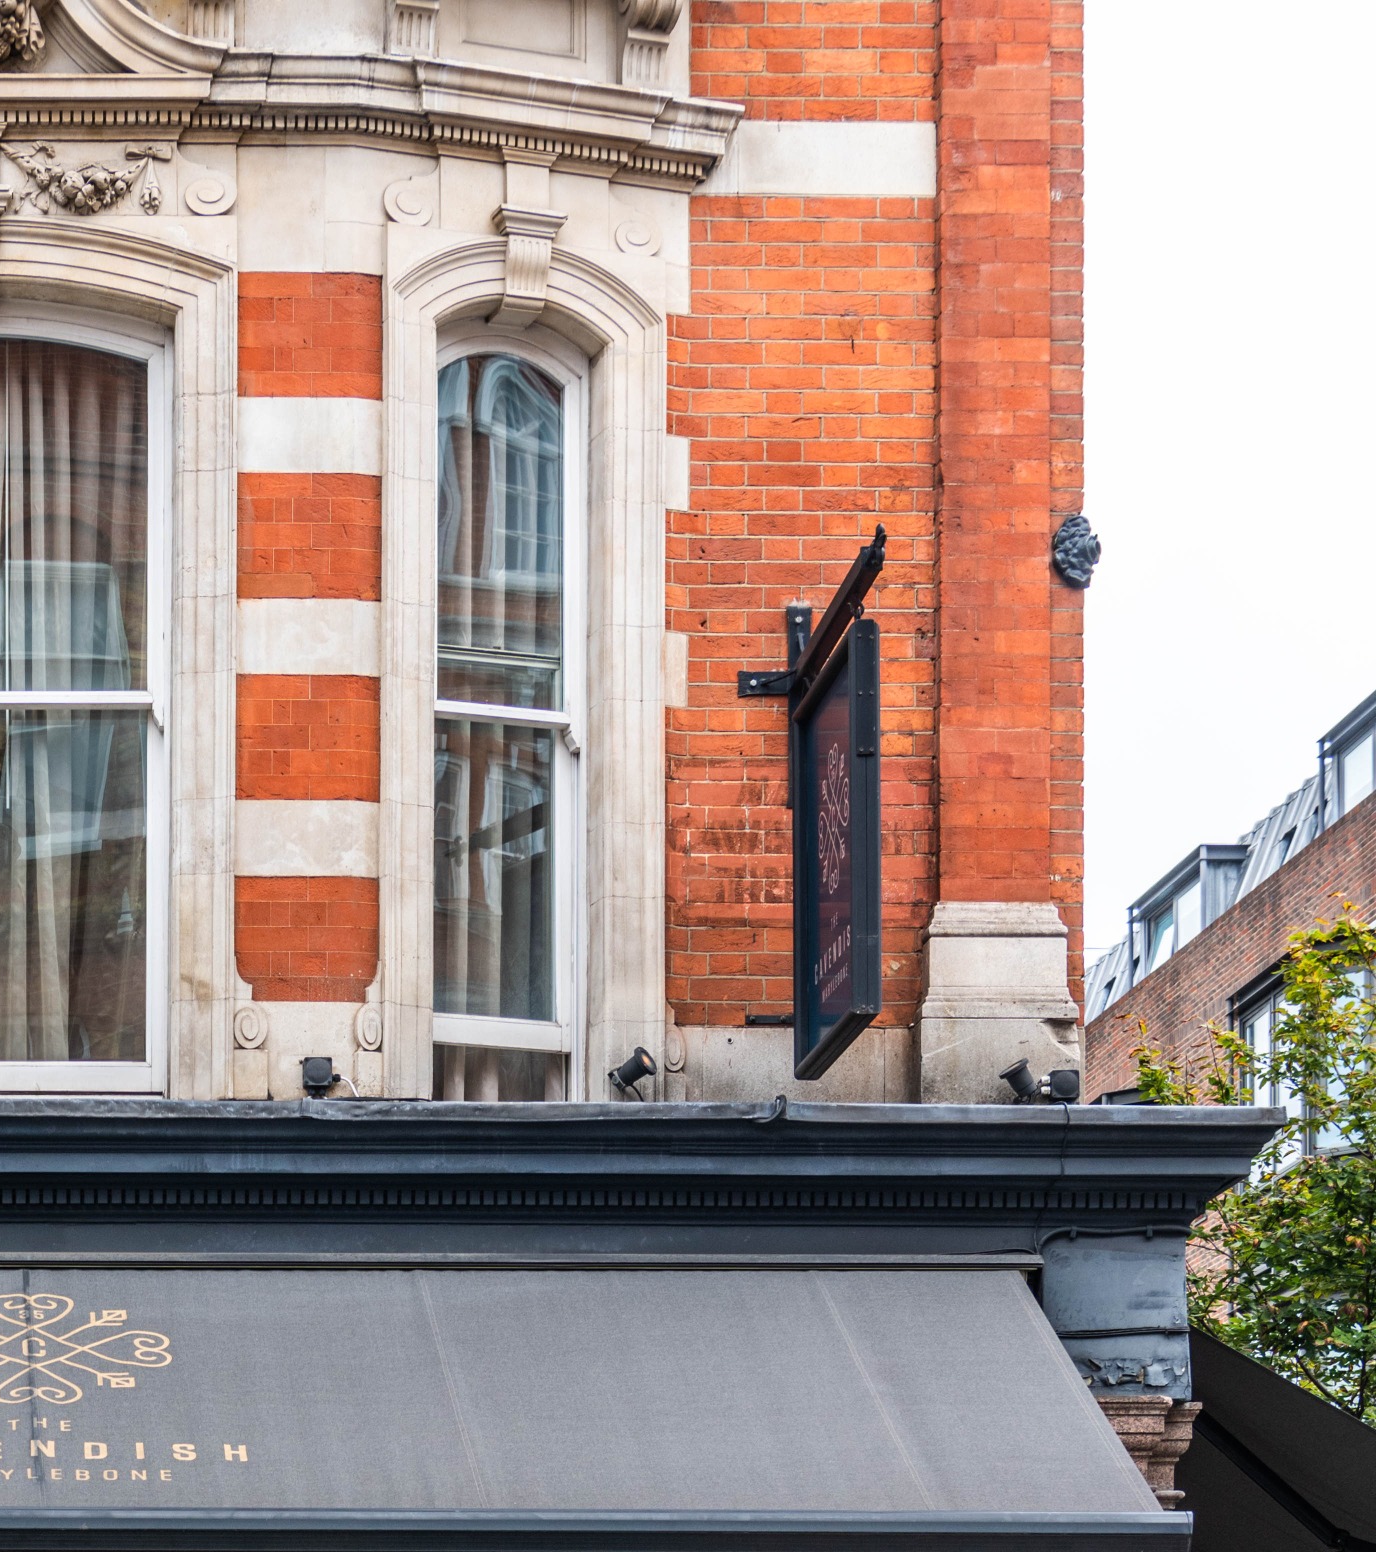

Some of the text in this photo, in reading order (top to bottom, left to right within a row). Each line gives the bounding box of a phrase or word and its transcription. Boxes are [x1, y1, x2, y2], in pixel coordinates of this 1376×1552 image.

[830, 912, 839, 931] THE
[821, 962, 849, 1004] MARYLEBONE
[18, 1310, 45, 1320] 35
[7, 1417, 73, 1432] THE
